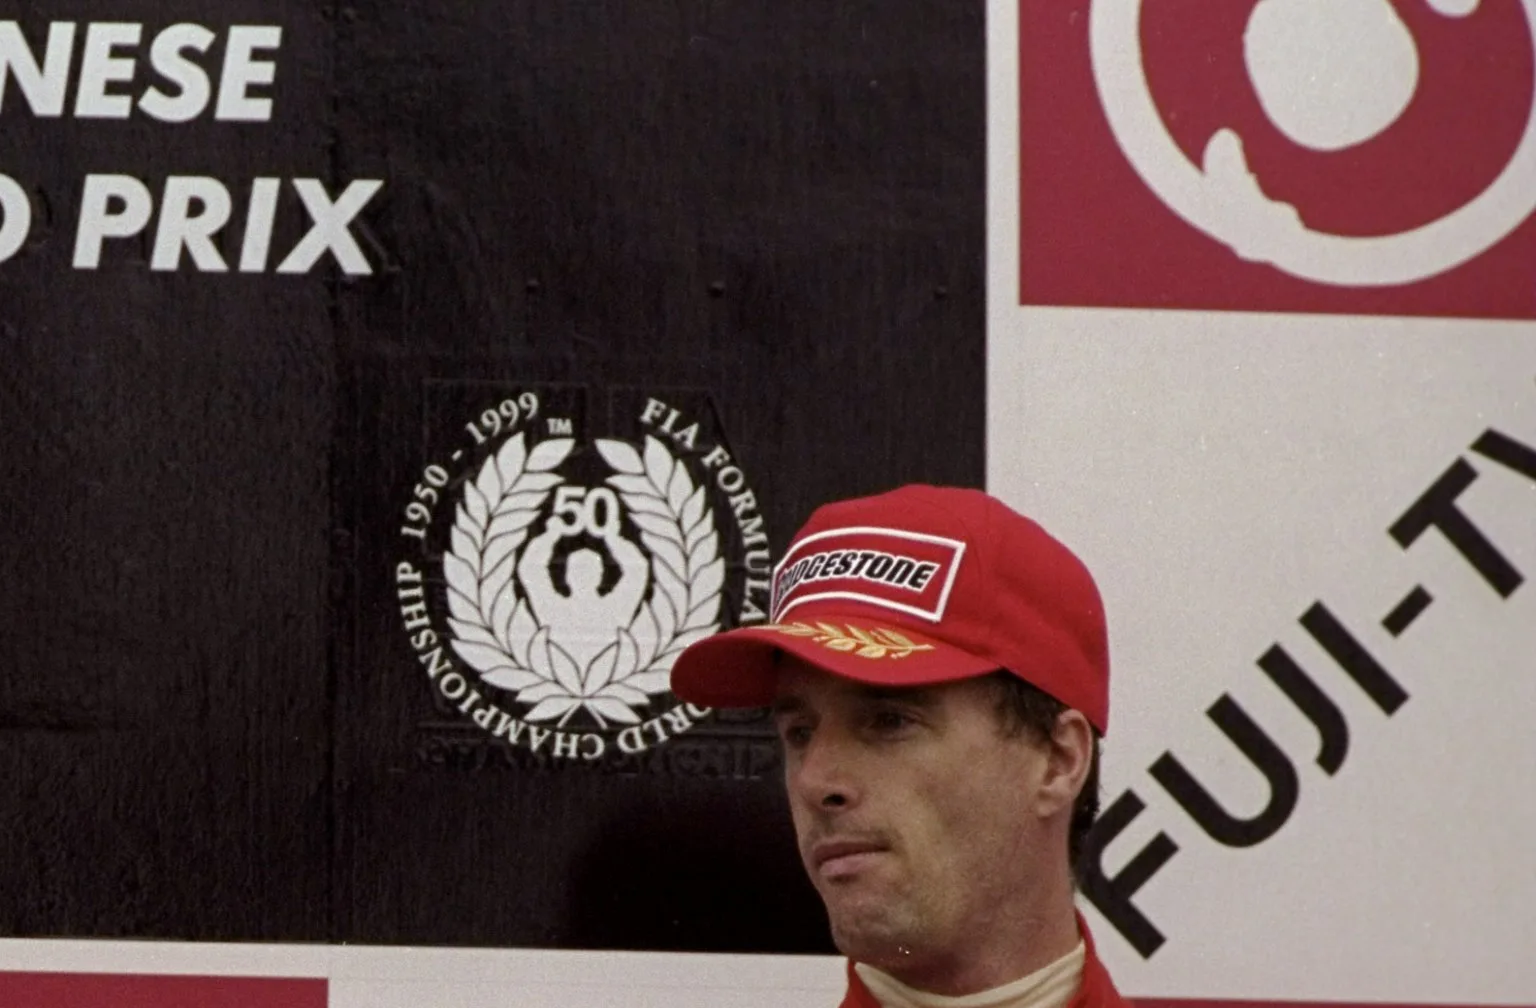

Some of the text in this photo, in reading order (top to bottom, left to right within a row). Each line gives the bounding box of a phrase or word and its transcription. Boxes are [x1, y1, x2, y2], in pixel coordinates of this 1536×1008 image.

[72, 174, 384, 275] PRIX
[465, 391, 539, 445] 1999
[639, 397, 701, 450] FIA
[401, 463, 450, 540] 1950
[552, 485, 620, 537] 50
[701, 445, 772, 624] FORMULA
[396, 561, 606, 760] CHAMPIONSHIP
